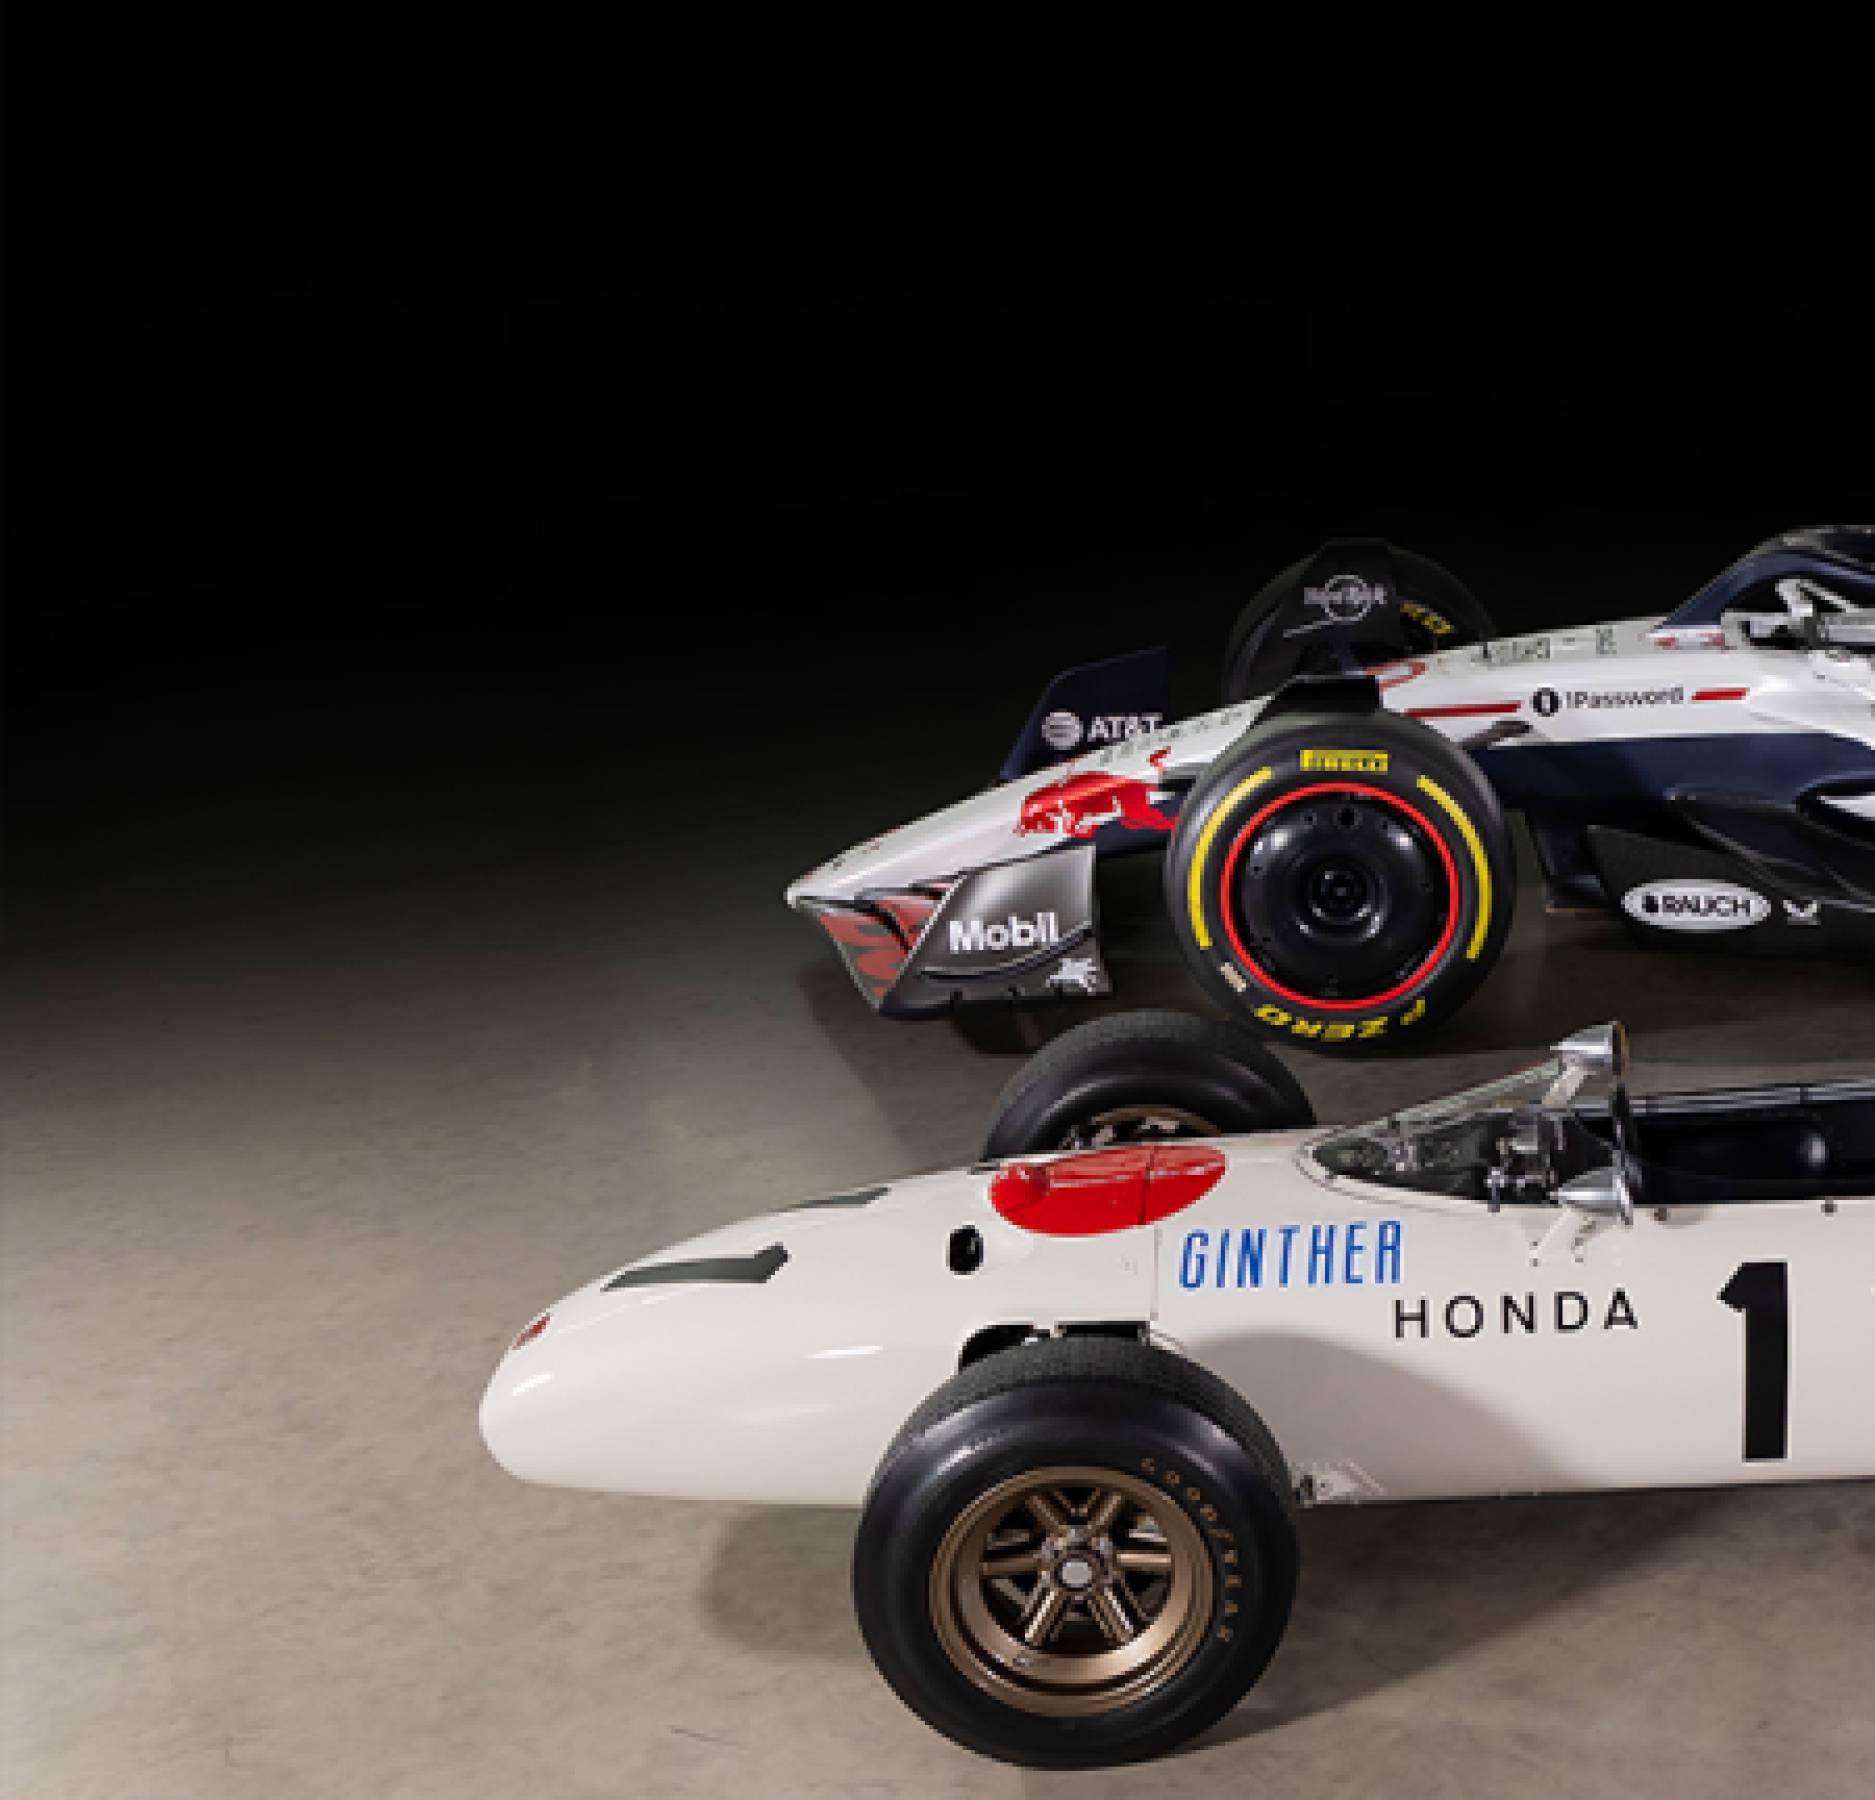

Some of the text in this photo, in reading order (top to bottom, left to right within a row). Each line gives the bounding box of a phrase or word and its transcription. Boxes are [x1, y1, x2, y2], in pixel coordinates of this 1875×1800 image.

[1566, 686, 1684, 709] 1Password
[1087, 712, 1164, 742] AT&T
[1661, 893, 1752, 918] RAUCH
[948, 912, 1060, 954] Mobil
[1253, 998, 1426, 1042] P ZERO
[1178, 1220, 1403, 1290] GINTHER
[1393, 1290, 1640, 1339] HONDA
